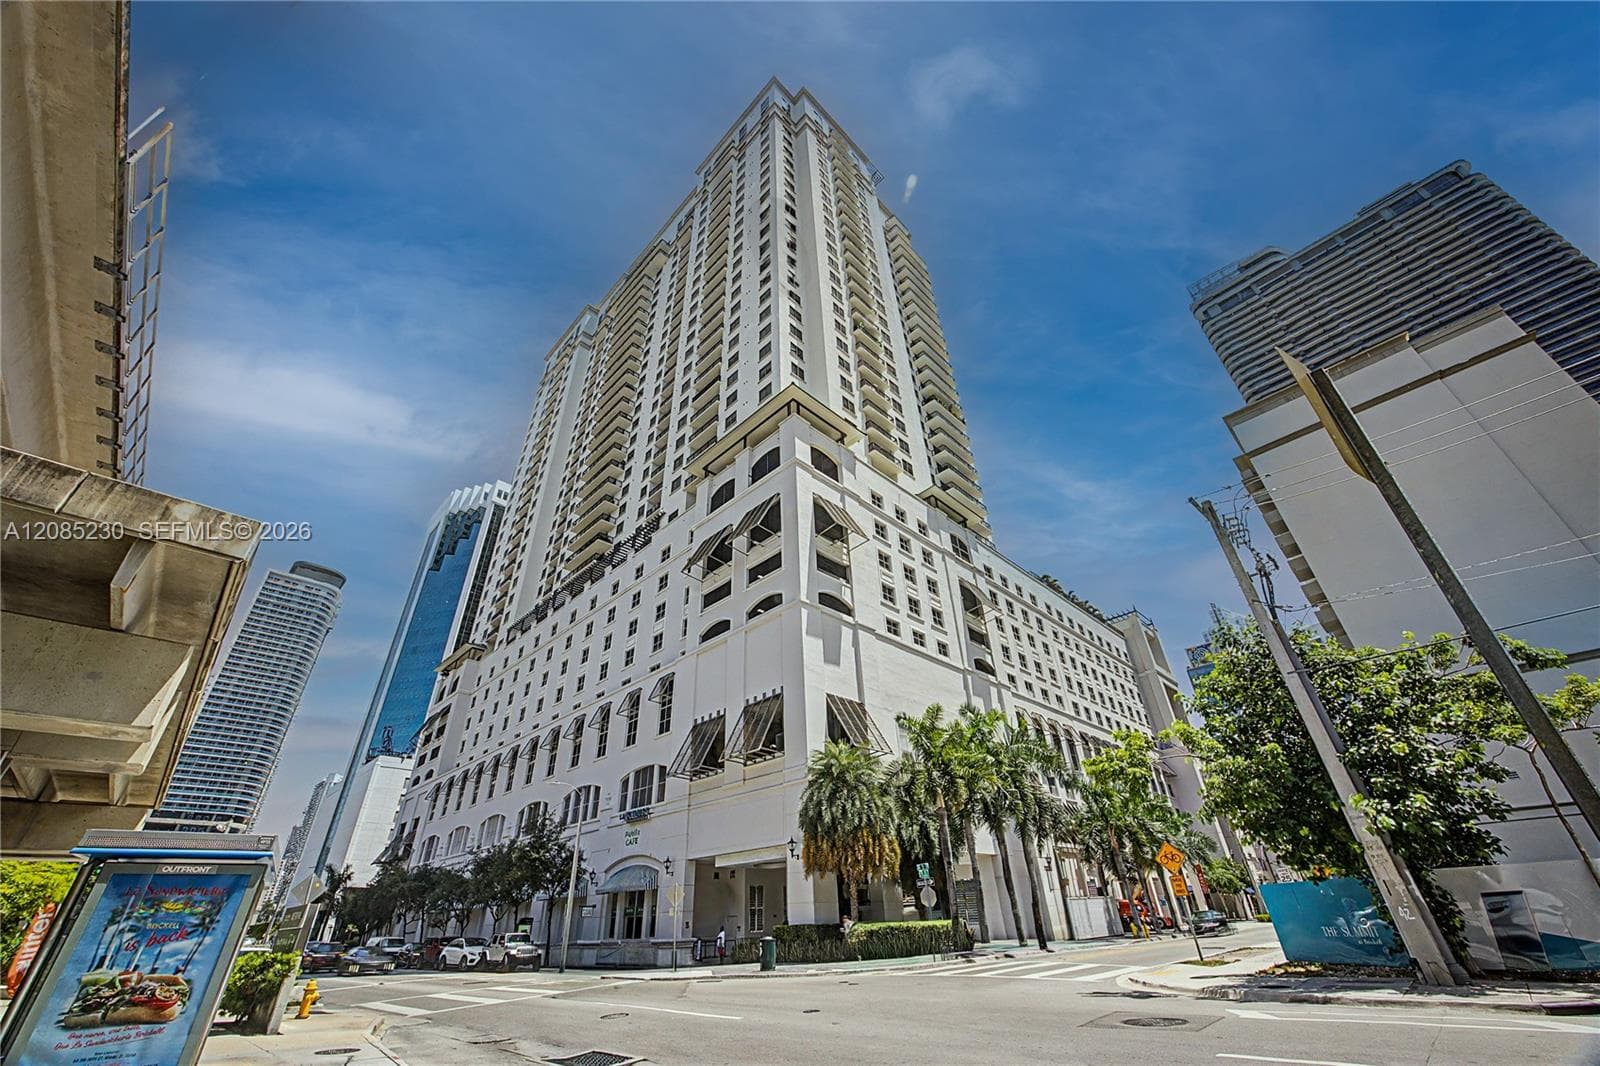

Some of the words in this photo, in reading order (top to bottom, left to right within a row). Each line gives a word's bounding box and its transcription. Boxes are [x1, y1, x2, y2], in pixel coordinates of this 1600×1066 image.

[145, 926, 189, 947] back
[1321, 926, 1340, 936] THE
[1340, 926, 1379, 937] SUMMIT
